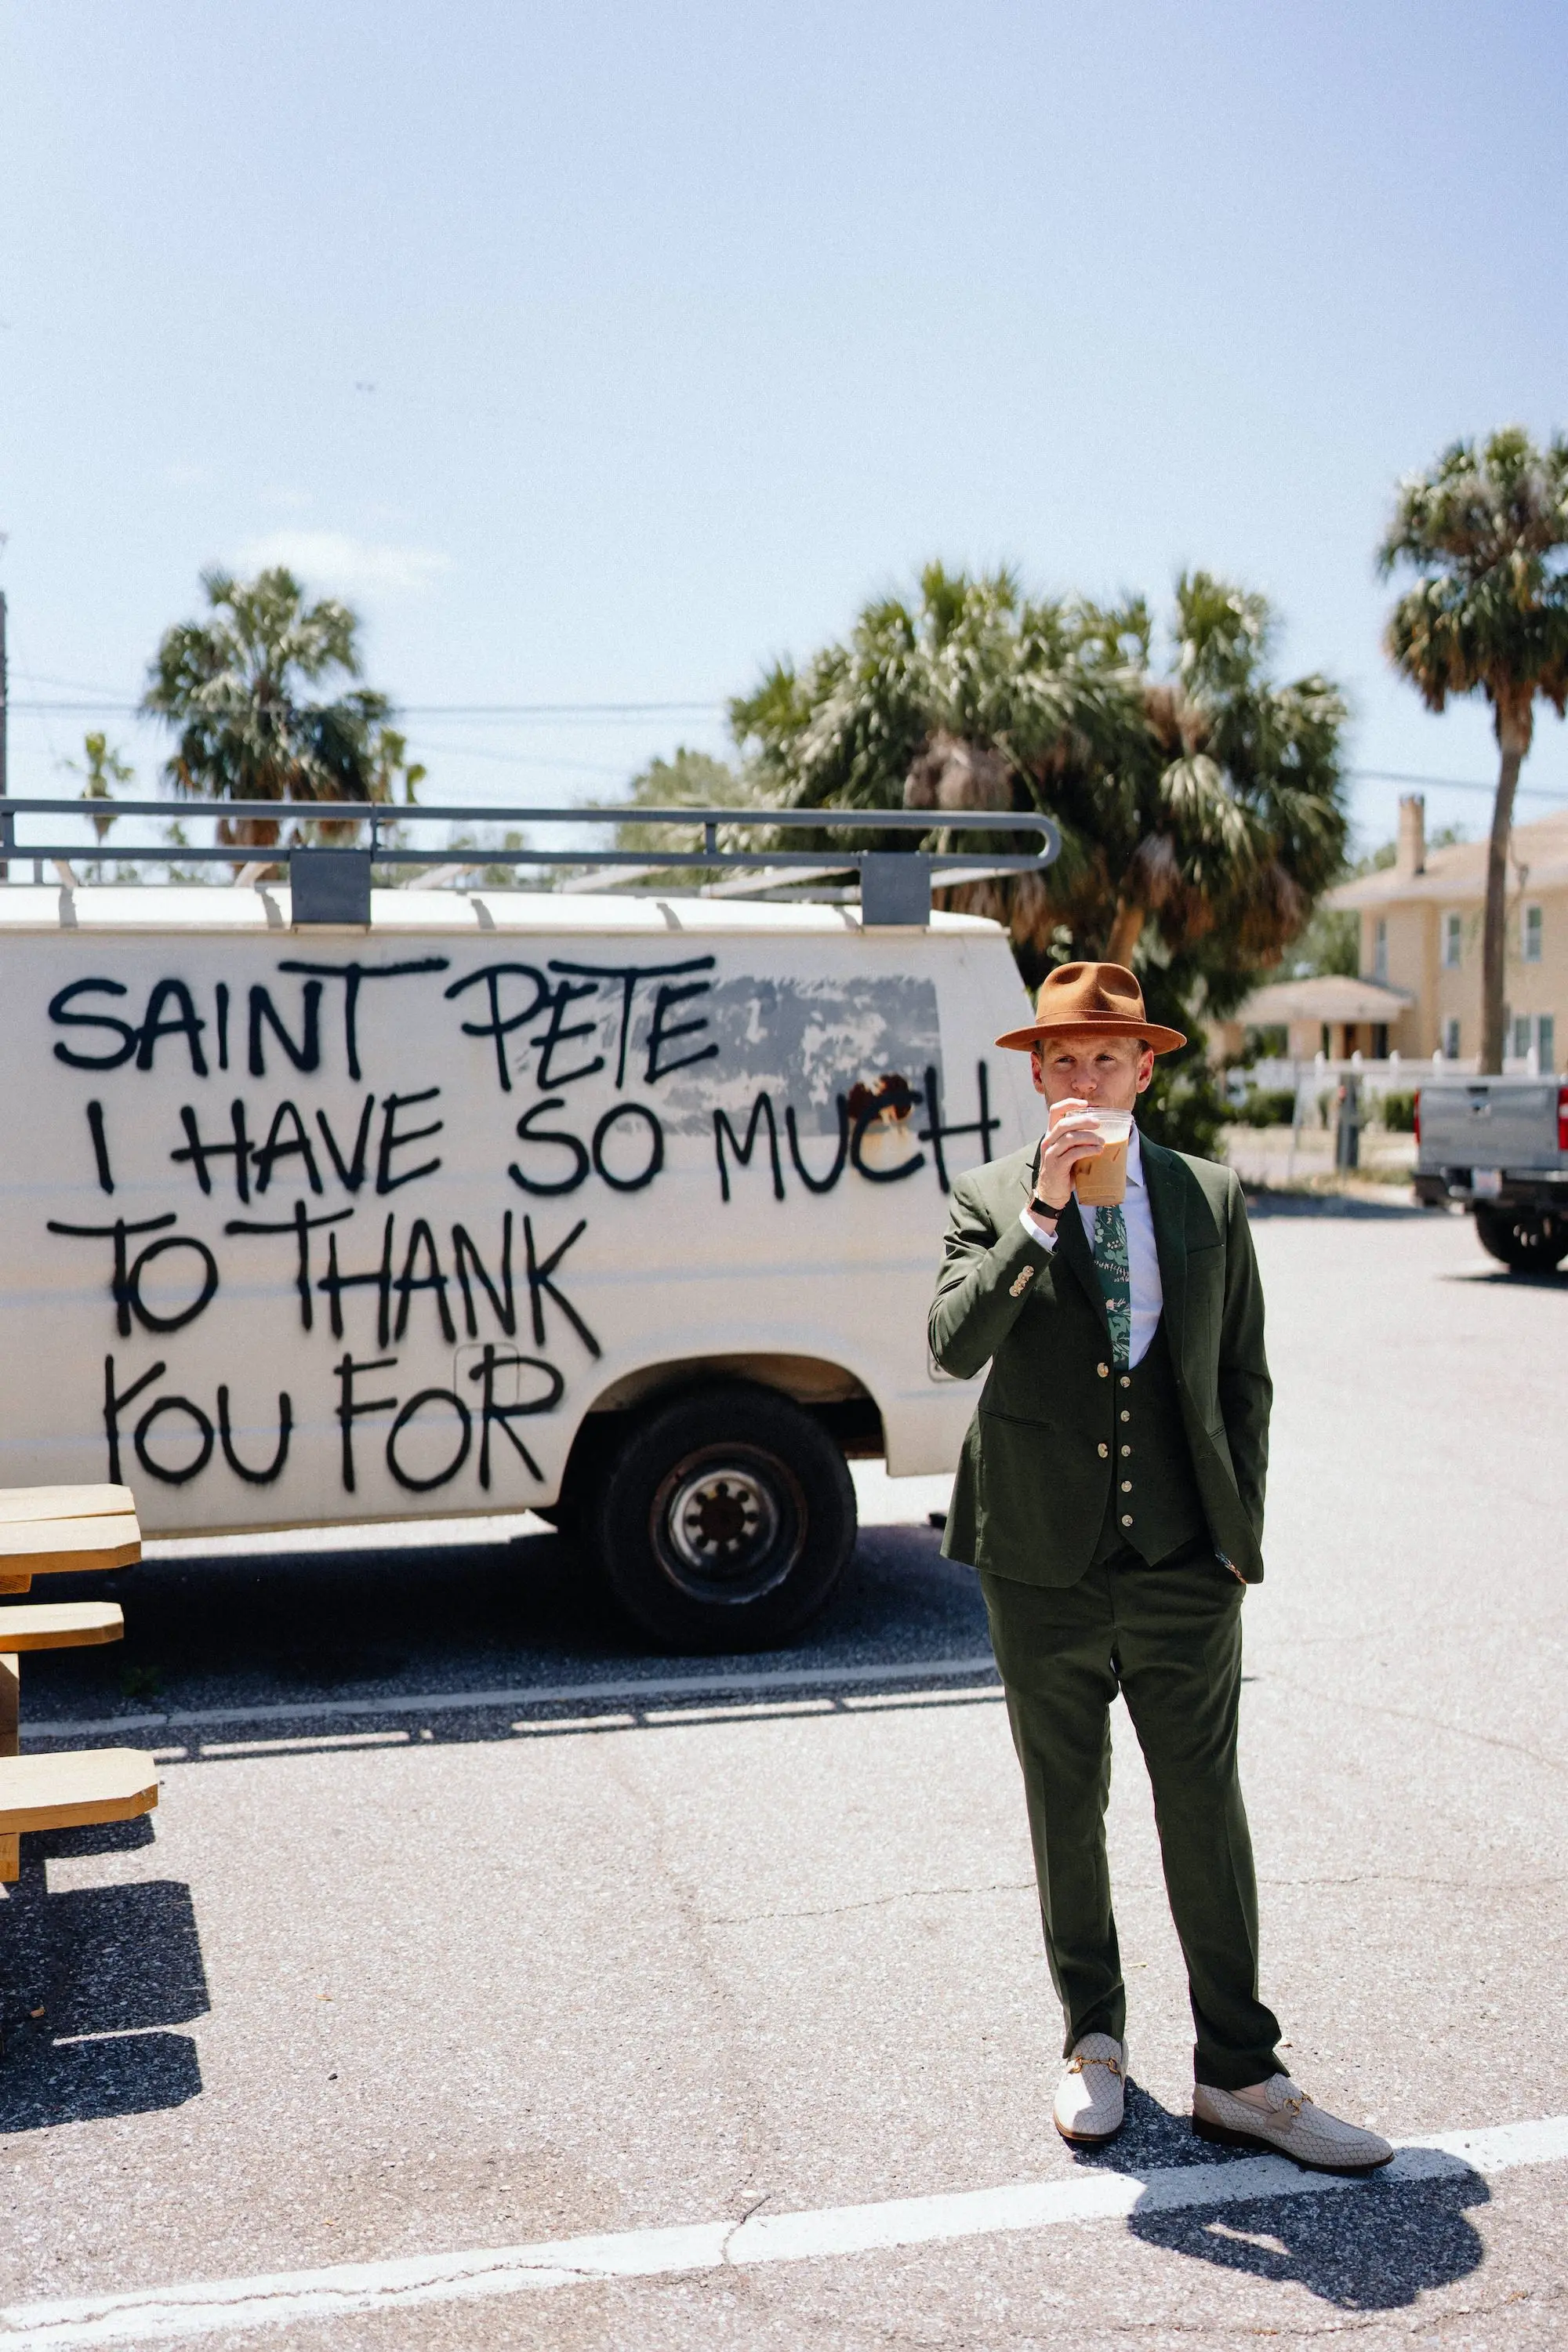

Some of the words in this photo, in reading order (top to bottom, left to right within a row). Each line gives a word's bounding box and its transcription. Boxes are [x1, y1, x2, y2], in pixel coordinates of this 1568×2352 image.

[47, 958, 450, 1081] SAINT
[444, 954, 717, 1093] PETE
[86, 1099, 115, 1196] I
[170, 1086, 445, 1203] HAVE
[507, 1098, 666, 1197] SO
[713, 1058, 1002, 1203] MUCH
[47, 1216, 220, 1338] TO
[223, 1200, 602, 1360] THANK
[102, 1354, 294, 1485] YOU
[332, 1343, 566, 1493] FOR
